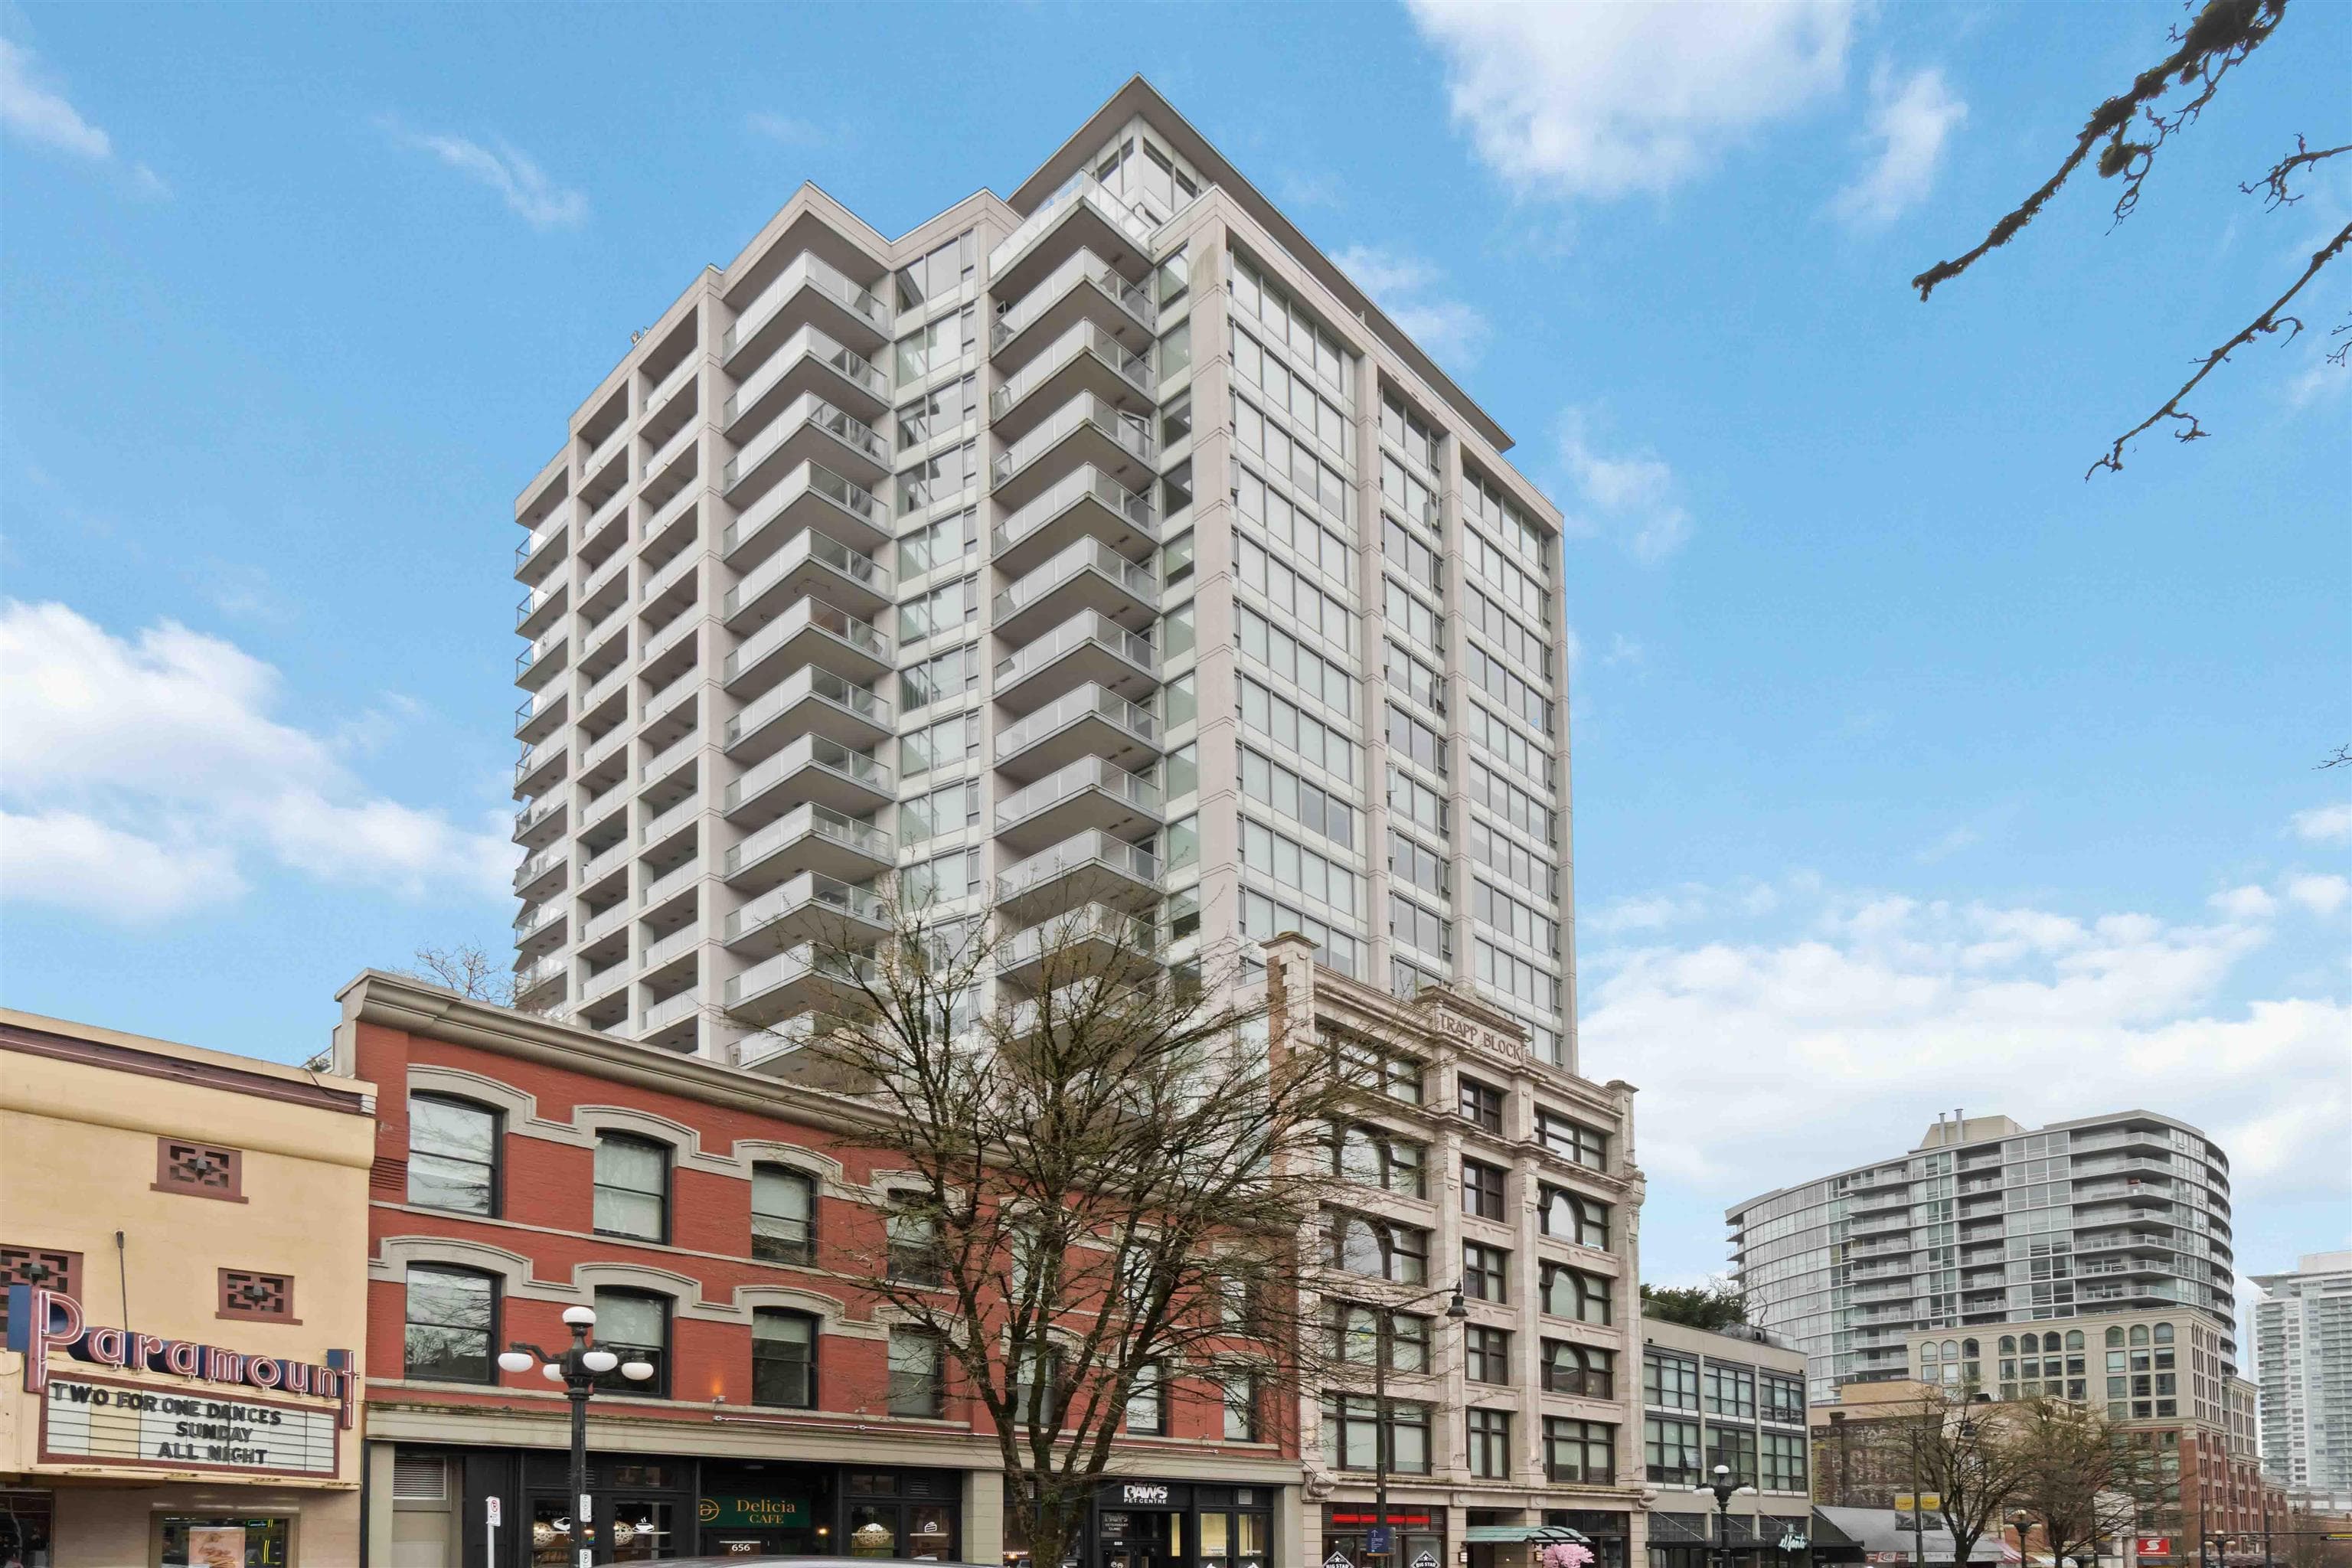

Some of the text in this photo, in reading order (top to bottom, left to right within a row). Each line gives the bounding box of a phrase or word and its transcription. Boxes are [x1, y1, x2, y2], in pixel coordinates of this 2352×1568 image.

[1439, 1013, 1521, 1062] TRAPP BLOCK
[25, 1286, 361, 1429] Paramount
[50, 1382, 282, 1426] TWO FOR ONE DANCES
[175, 1421, 253, 1443] SUNDAY
[158, 1442, 268, 1465] ALL NIGHT
[1124, 1485, 1168, 1499] PAWS
[736, 1498, 796, 1513] Delicia
[749, 1514, 784, 1524] CAFE
[731, 1544, 750, 1552] 656
